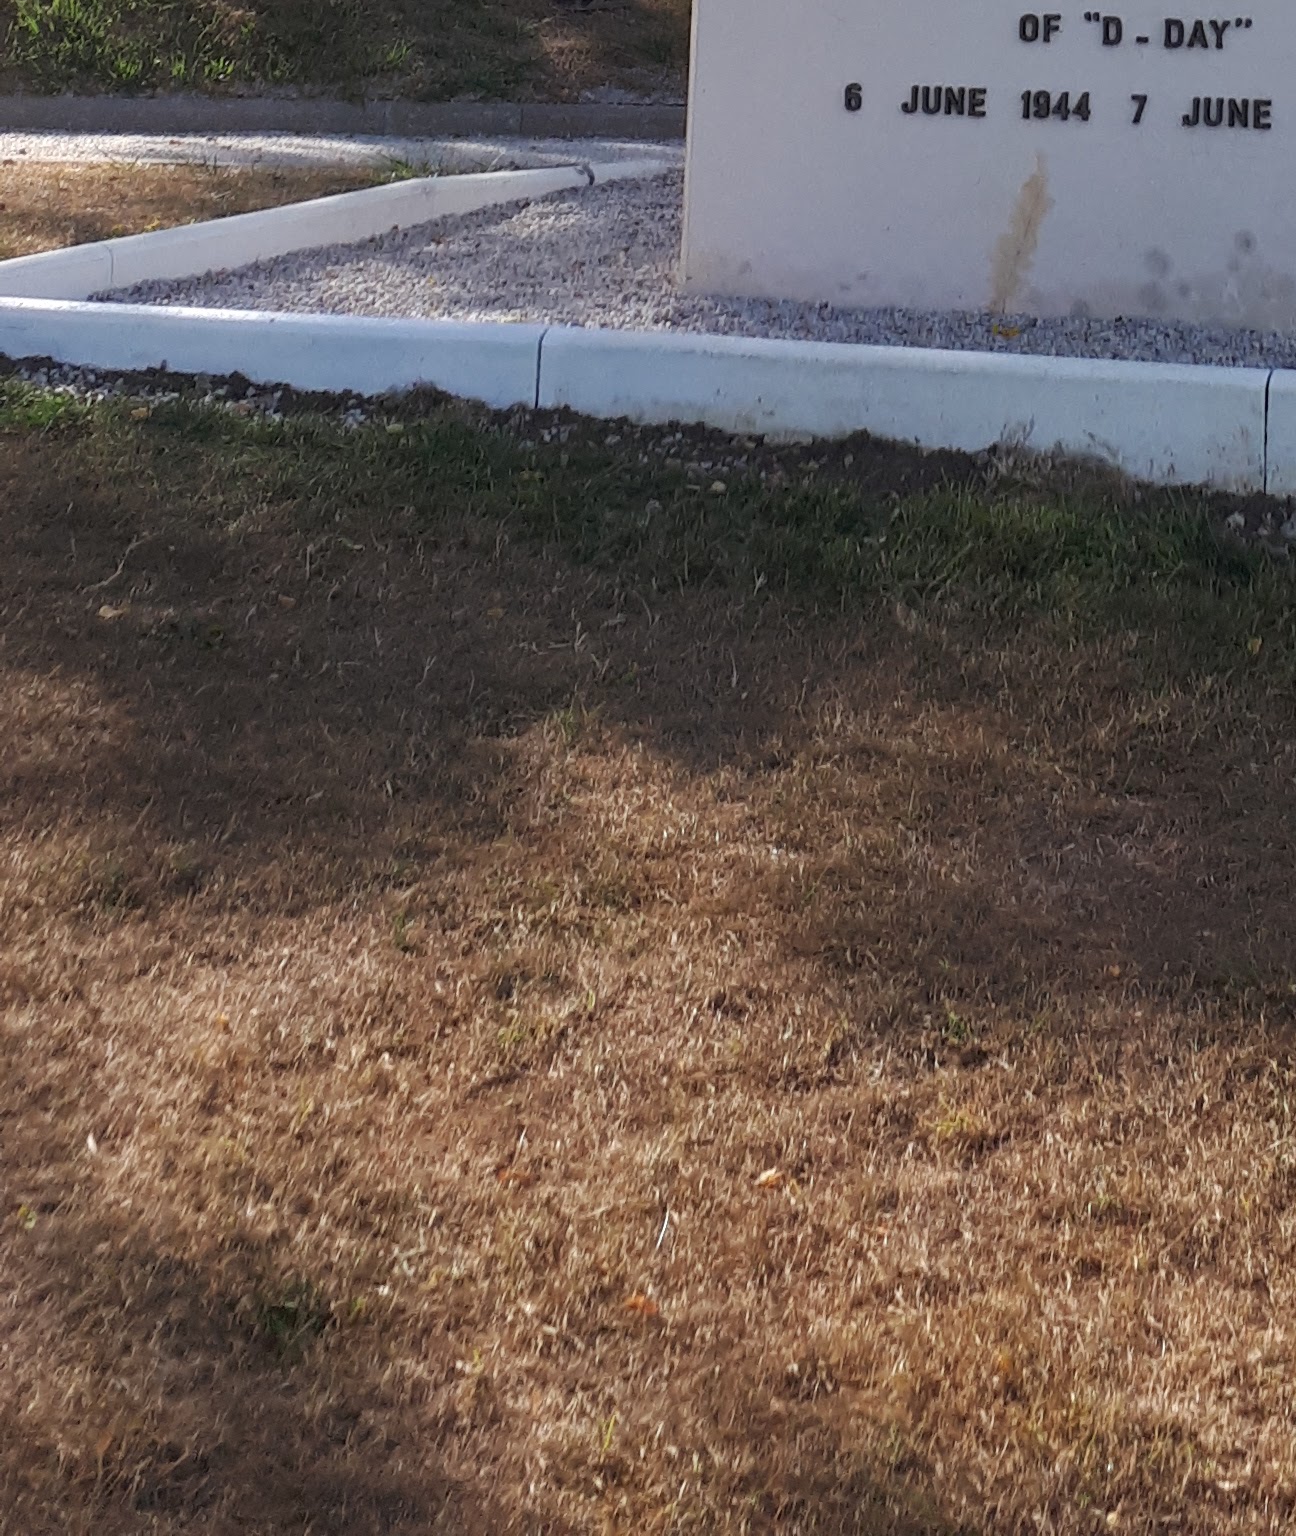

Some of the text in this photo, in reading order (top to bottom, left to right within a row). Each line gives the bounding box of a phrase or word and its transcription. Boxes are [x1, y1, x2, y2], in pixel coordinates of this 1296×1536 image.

[1018, 14, 1061, 44] OF
[844, 83, 862, 113] 6
[901, 85, 987, 118] JUNE
[1020, 90, 1092, 122] 1944
[1130, 94, 1149, 124] 7
[1182, 97, 1272, 130] JUNE
